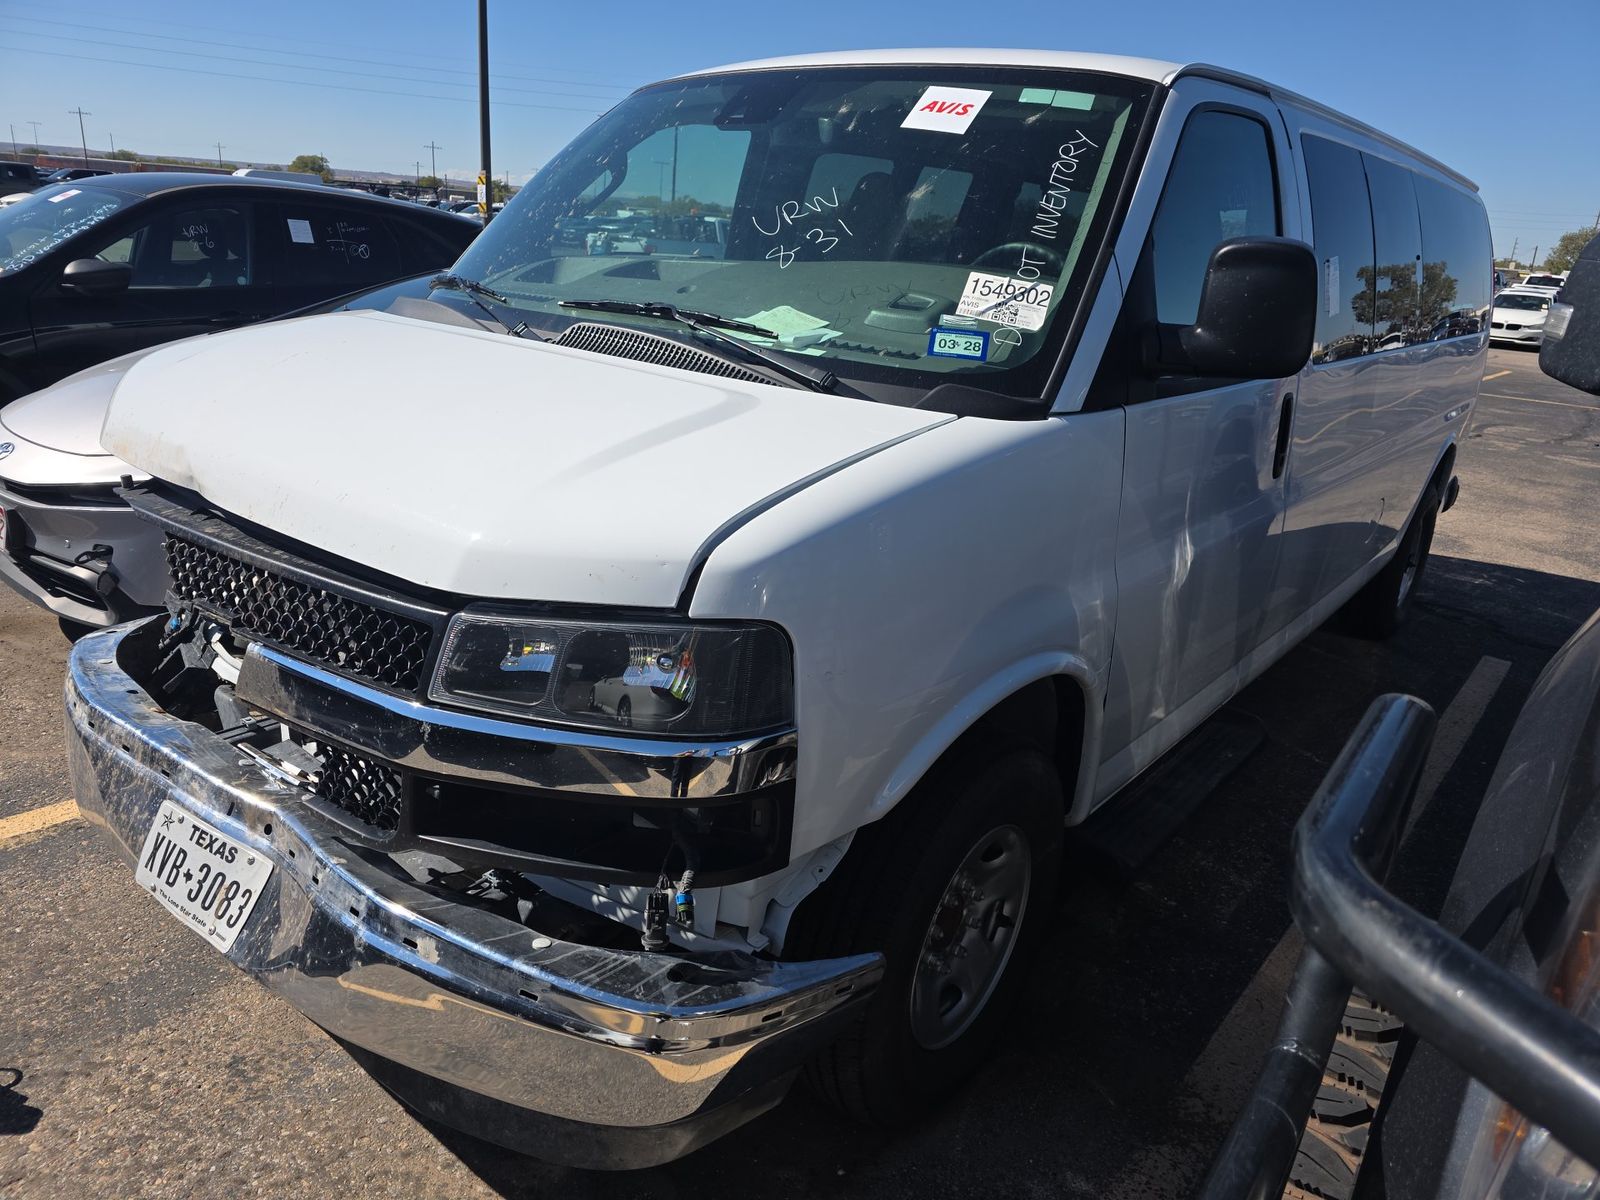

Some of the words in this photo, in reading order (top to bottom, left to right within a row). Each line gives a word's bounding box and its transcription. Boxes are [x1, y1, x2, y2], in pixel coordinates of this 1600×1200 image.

[919, 100, 975, 116] AVIS
[1030, 128, 1099, 240] INVENTORY
[960, 299, 979, 309] AVIS
[972, 277, 1051, 308] 1549302
[938, 338, 956, 350] 03
[963, 340, 982, 352] 28
[188, 824, 238, 864] TEXAS
[159, 888, 168, 899] The
[167, 896, 180, 909] Lone
[179, 905, 192, 917] Star
[191, 913, 207, 928] State
